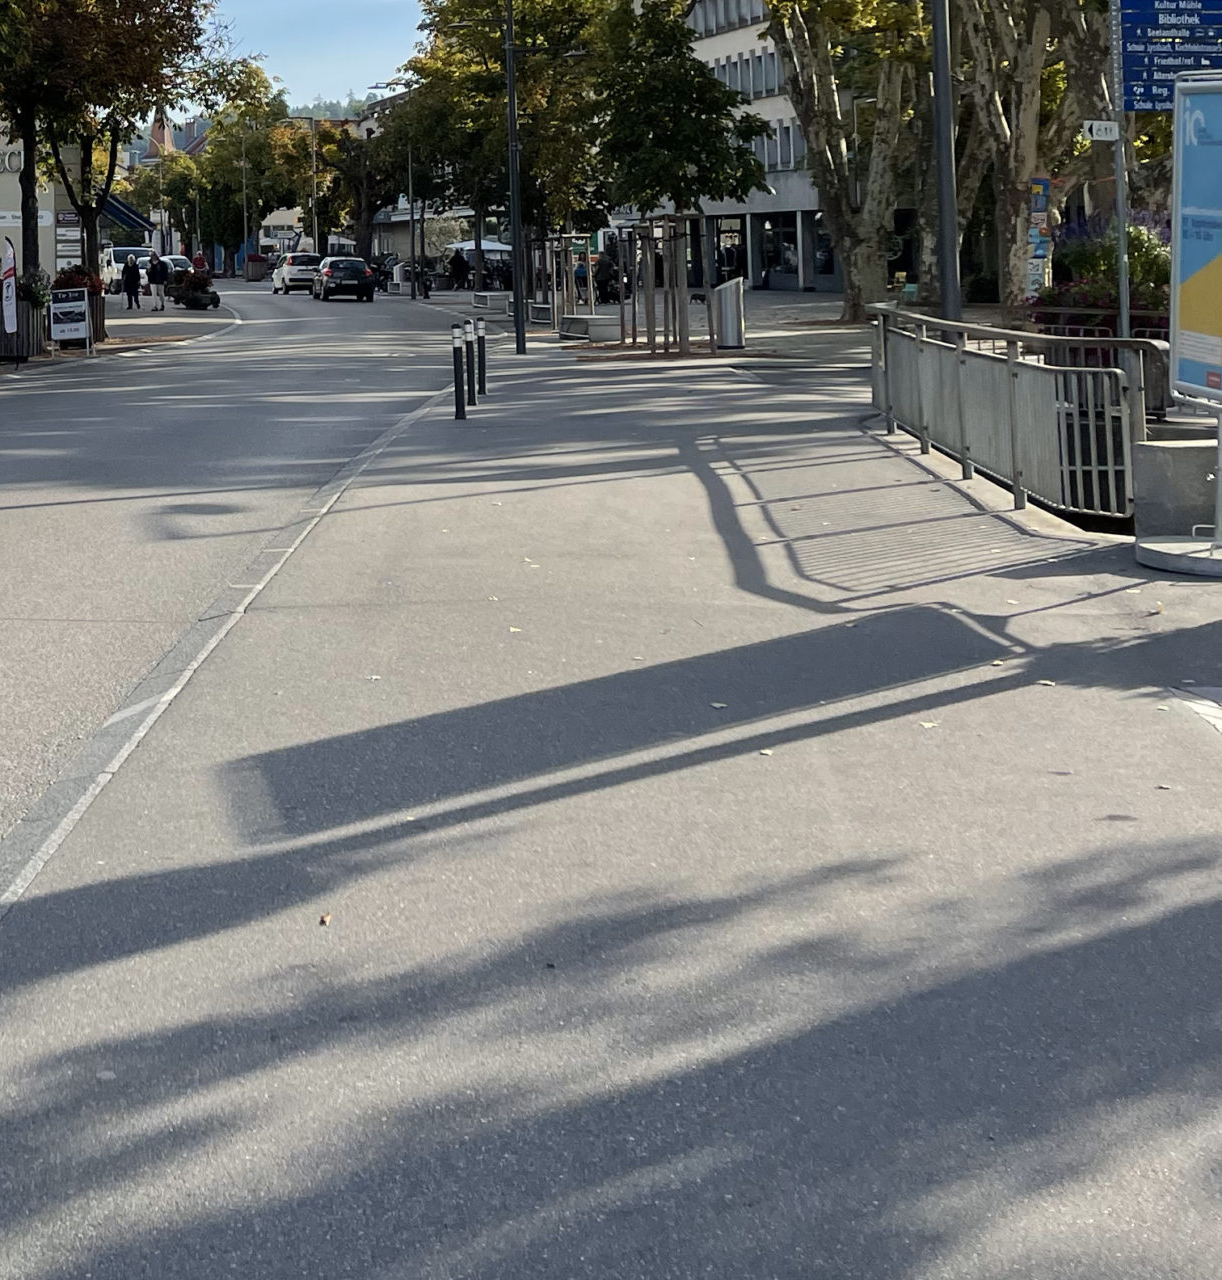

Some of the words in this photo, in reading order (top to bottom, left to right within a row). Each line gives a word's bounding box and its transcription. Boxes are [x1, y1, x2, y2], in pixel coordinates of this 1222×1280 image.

[1154, 0, 1178, 10] Kultur
[1158, 14, 1200, 25] Bibliothek
[1152, 86, 1171, 96] Reg.
